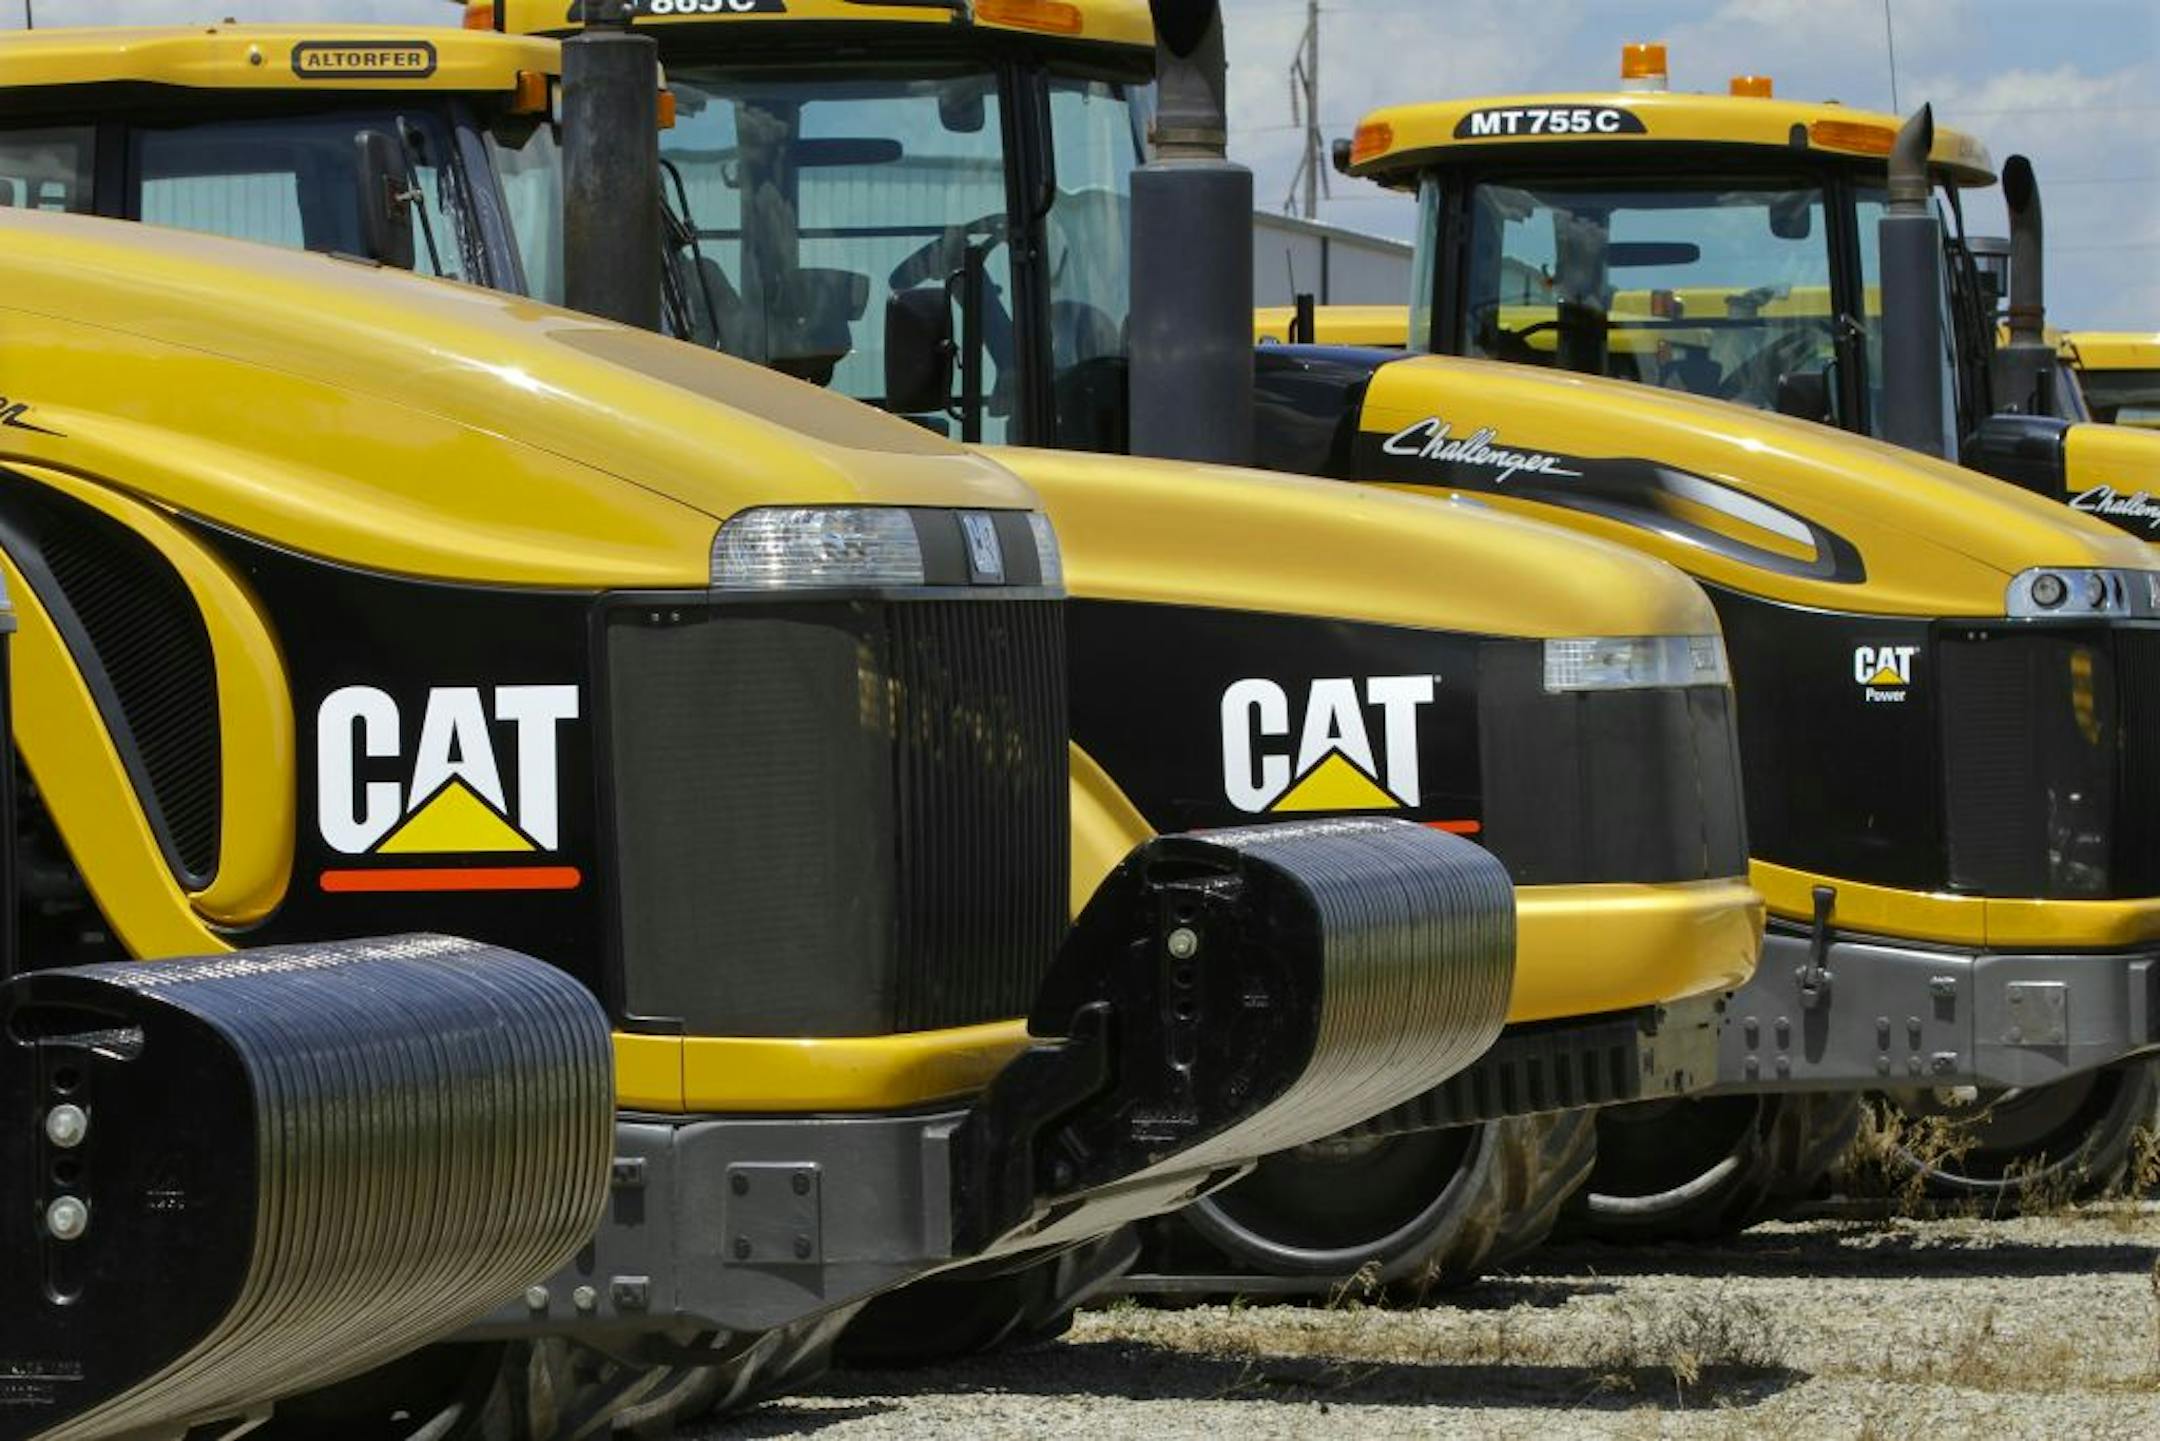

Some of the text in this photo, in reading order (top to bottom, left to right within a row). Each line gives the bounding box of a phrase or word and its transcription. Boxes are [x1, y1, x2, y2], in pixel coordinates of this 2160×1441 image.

[307, 52, 421, 67] ALTORFER
[1383, 416, 1583, 484] Challenger
[1855, 646, 1915, 685] CAT
[1865, 687, 1906, 702] Power
[317, 685, 579, 853] CAT
[1221, 675, 1434, 813] CAT
